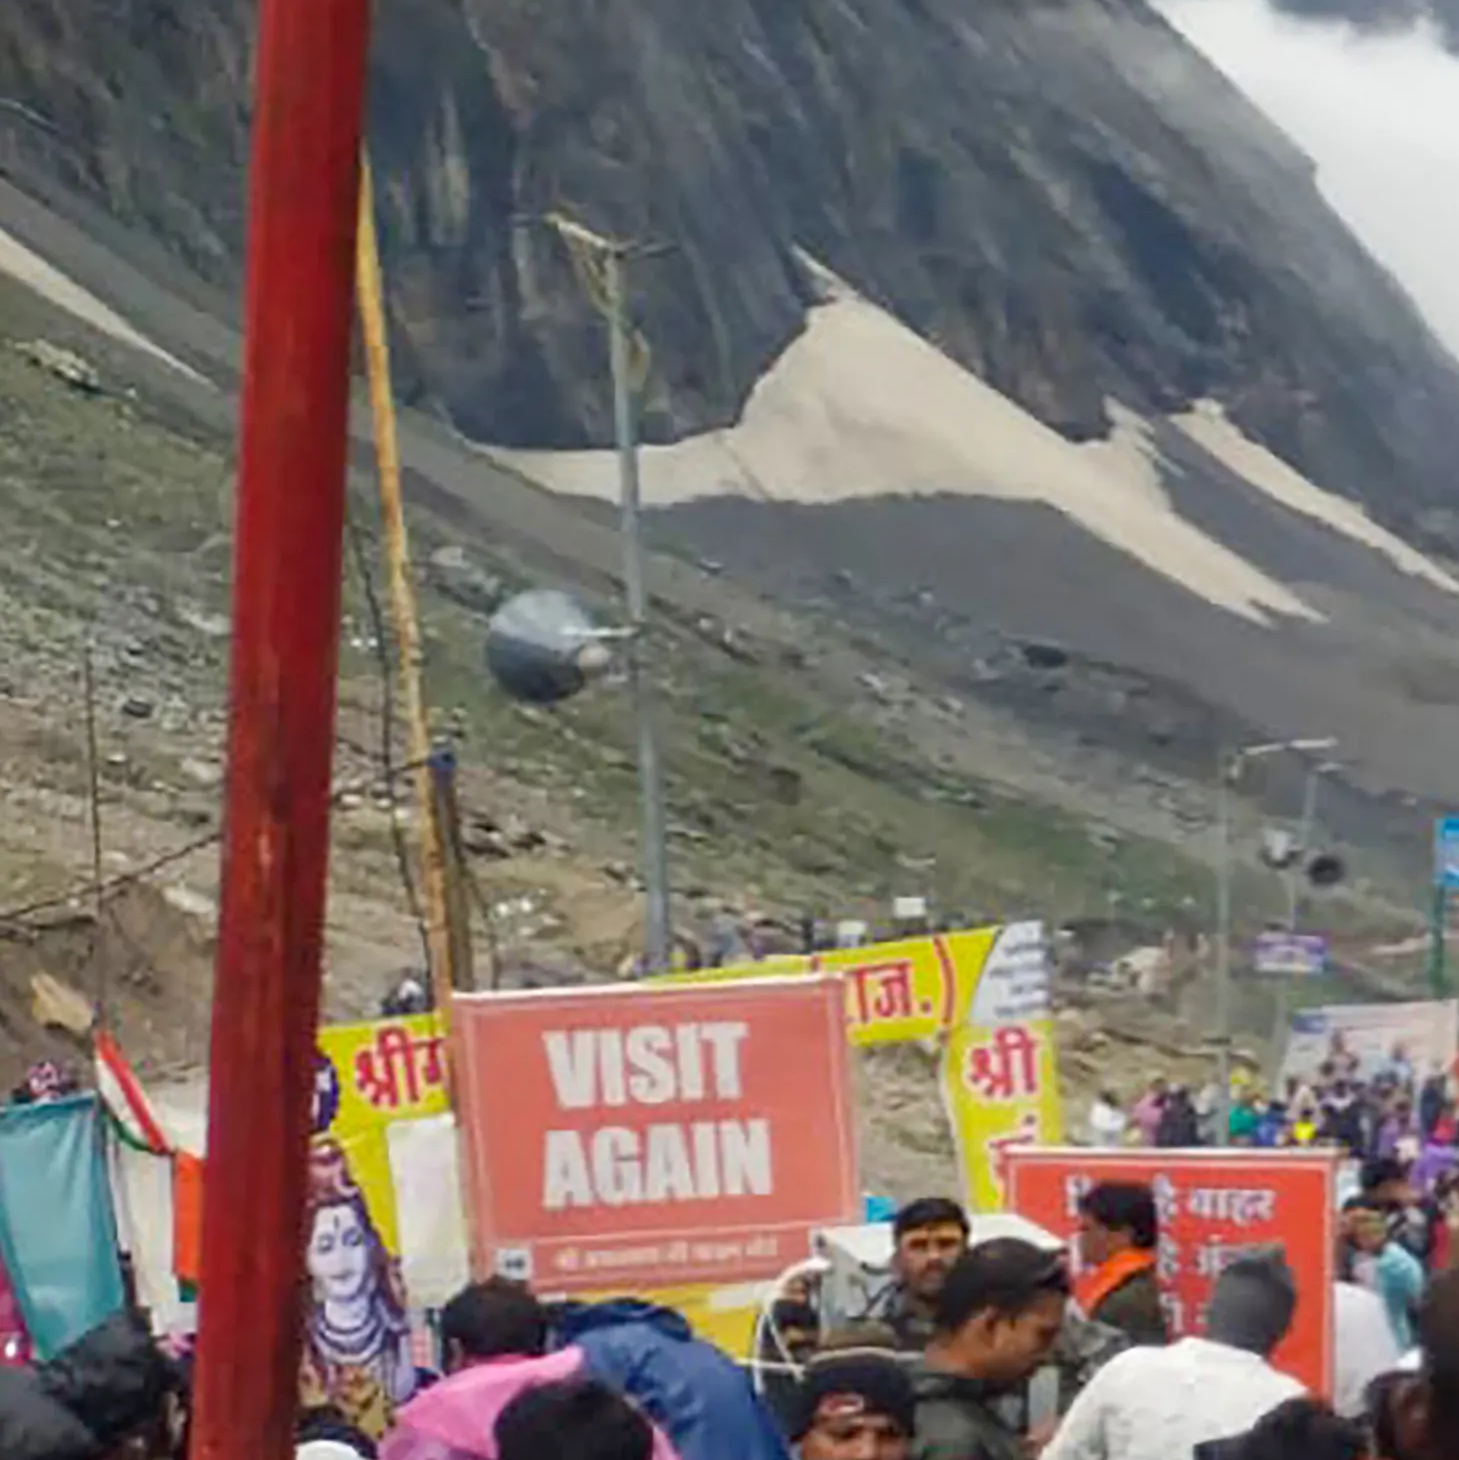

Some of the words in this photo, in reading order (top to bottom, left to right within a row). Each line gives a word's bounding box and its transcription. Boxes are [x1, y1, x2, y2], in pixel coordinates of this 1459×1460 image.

[541, 1022, 749, 1109] VISIT
[970, 1027, 1035, 1098] श्री
[541, 1118, 772, 1210] AGAIN
